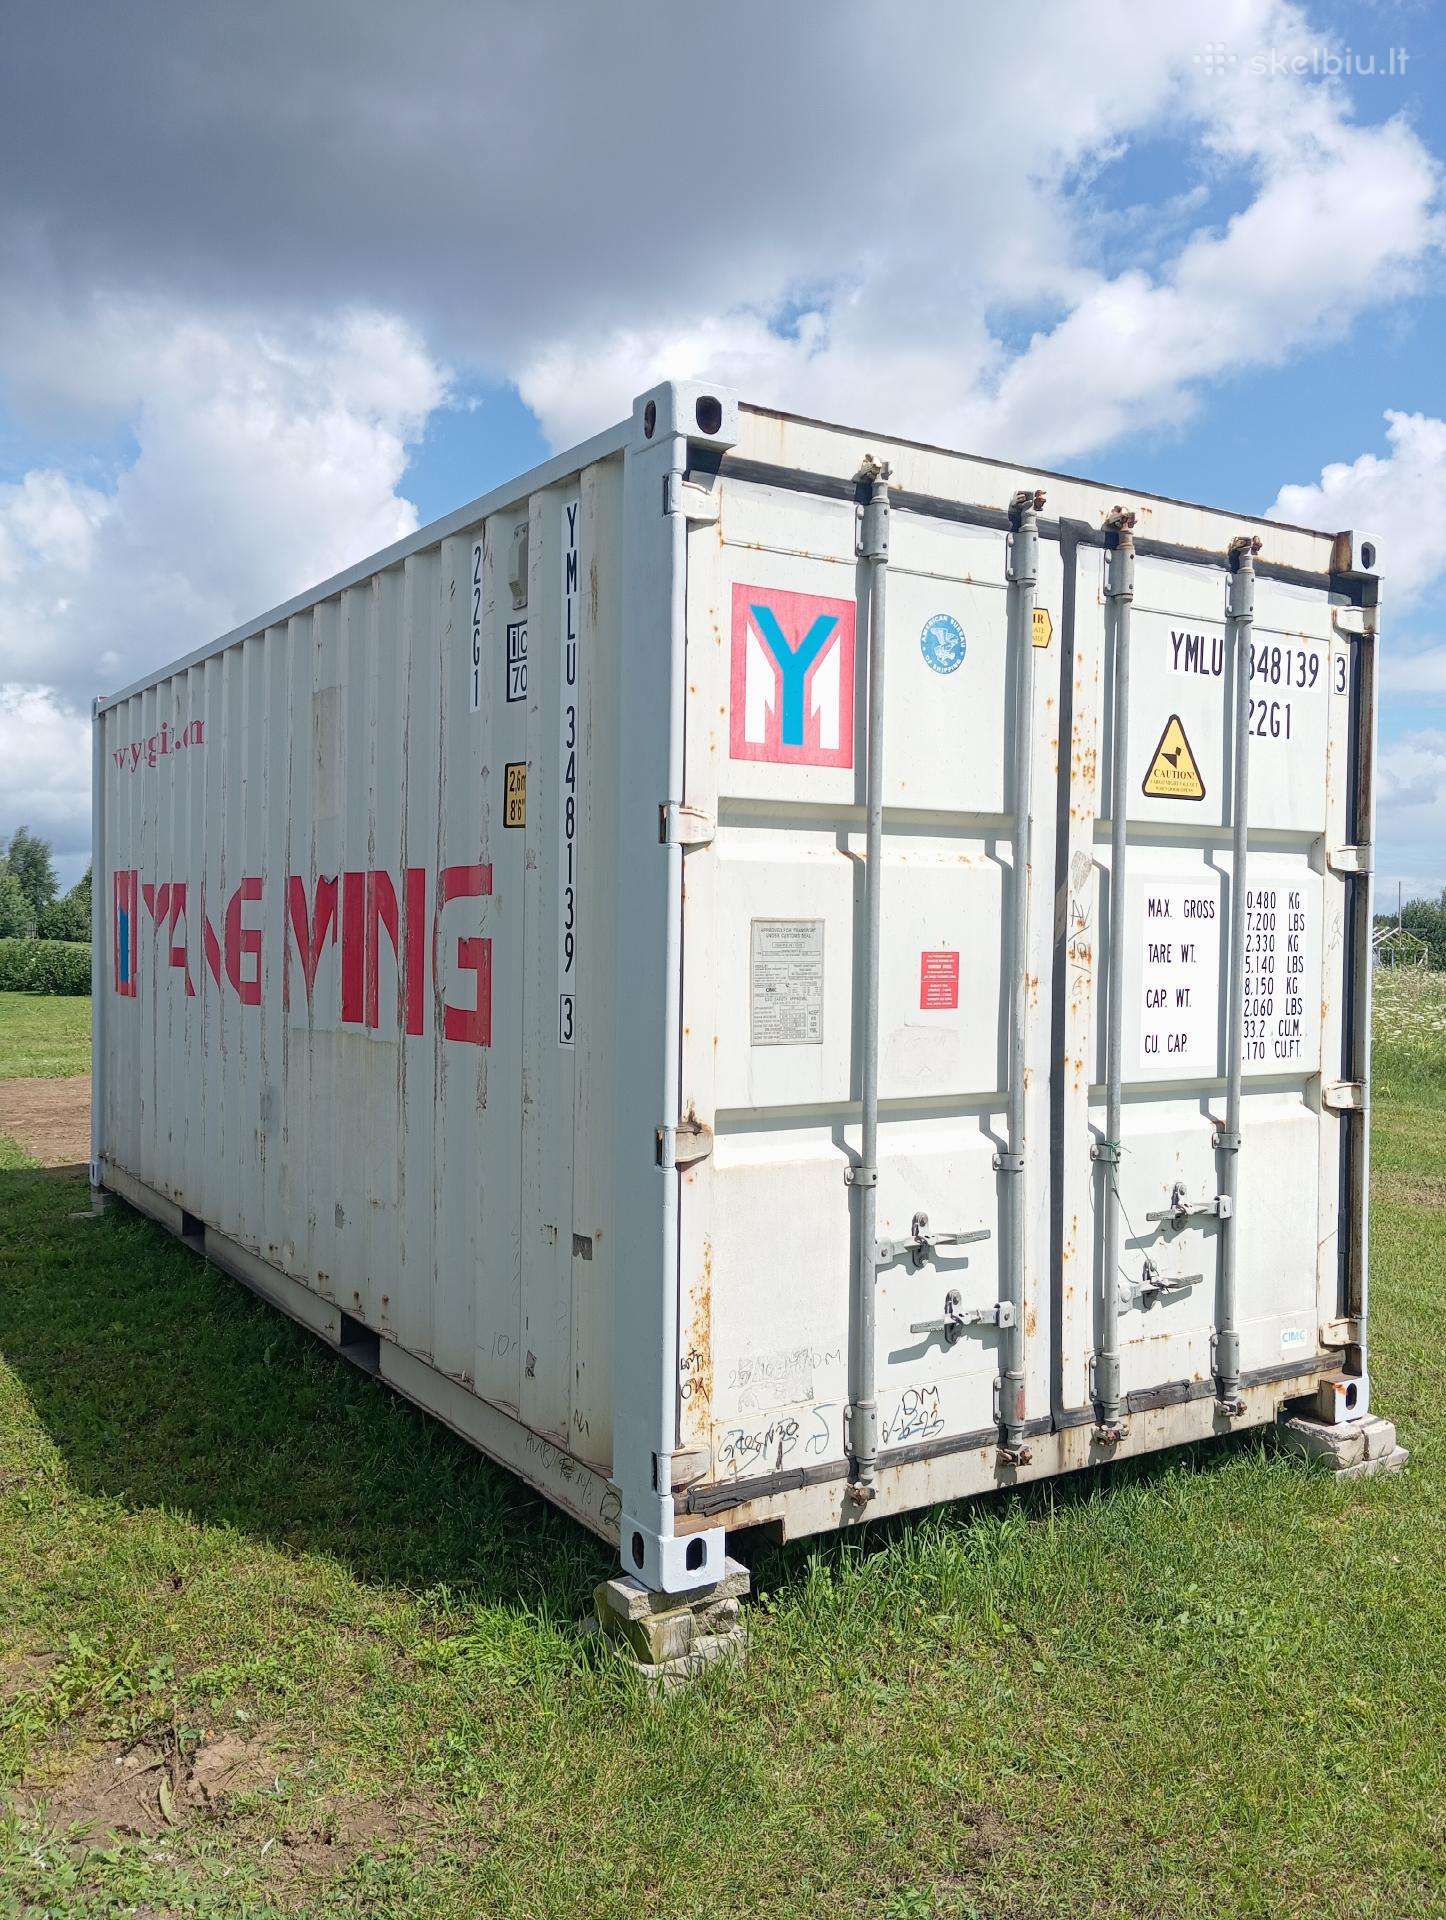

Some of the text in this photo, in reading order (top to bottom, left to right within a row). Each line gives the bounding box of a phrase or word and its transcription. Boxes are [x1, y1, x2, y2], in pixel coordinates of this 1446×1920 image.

[472, 545, 482, 707] 22G1
[1171, 631, 1223, 676] YMLU
[1336, 656, 1346, 692] 3
[512, 664, 528, 693] 70
[1149, 899, 1215, 919] MAX. GROSS
[1247, 891, 1300, 909] 0.480 KG
[1246, 912, 1305, 931] 7.200 LBS
[1149, 943, 1196, 963] TARE WT.
[1246, 934, 1299, 952] 2.330 KG
[1245, 955, 1304, 973] 5.140 LBS
[1244, 977, 1298, 995] 8.150 KG
[1147, 987, 1192, 1008] CAP. WT.
[1244, 998, 1303, 1017] 2.060 LBS
[564, 998, 572, 1040] 3
[1244, 1019, 1302, 1037] 33.2 CU.M.
[1145, 1033, 1187, 1053] CU. CAP.
[1242, 1040, 1302, 1060] .170 CU.FT.
[1282, 1329, 1305, 1343] CIMC
